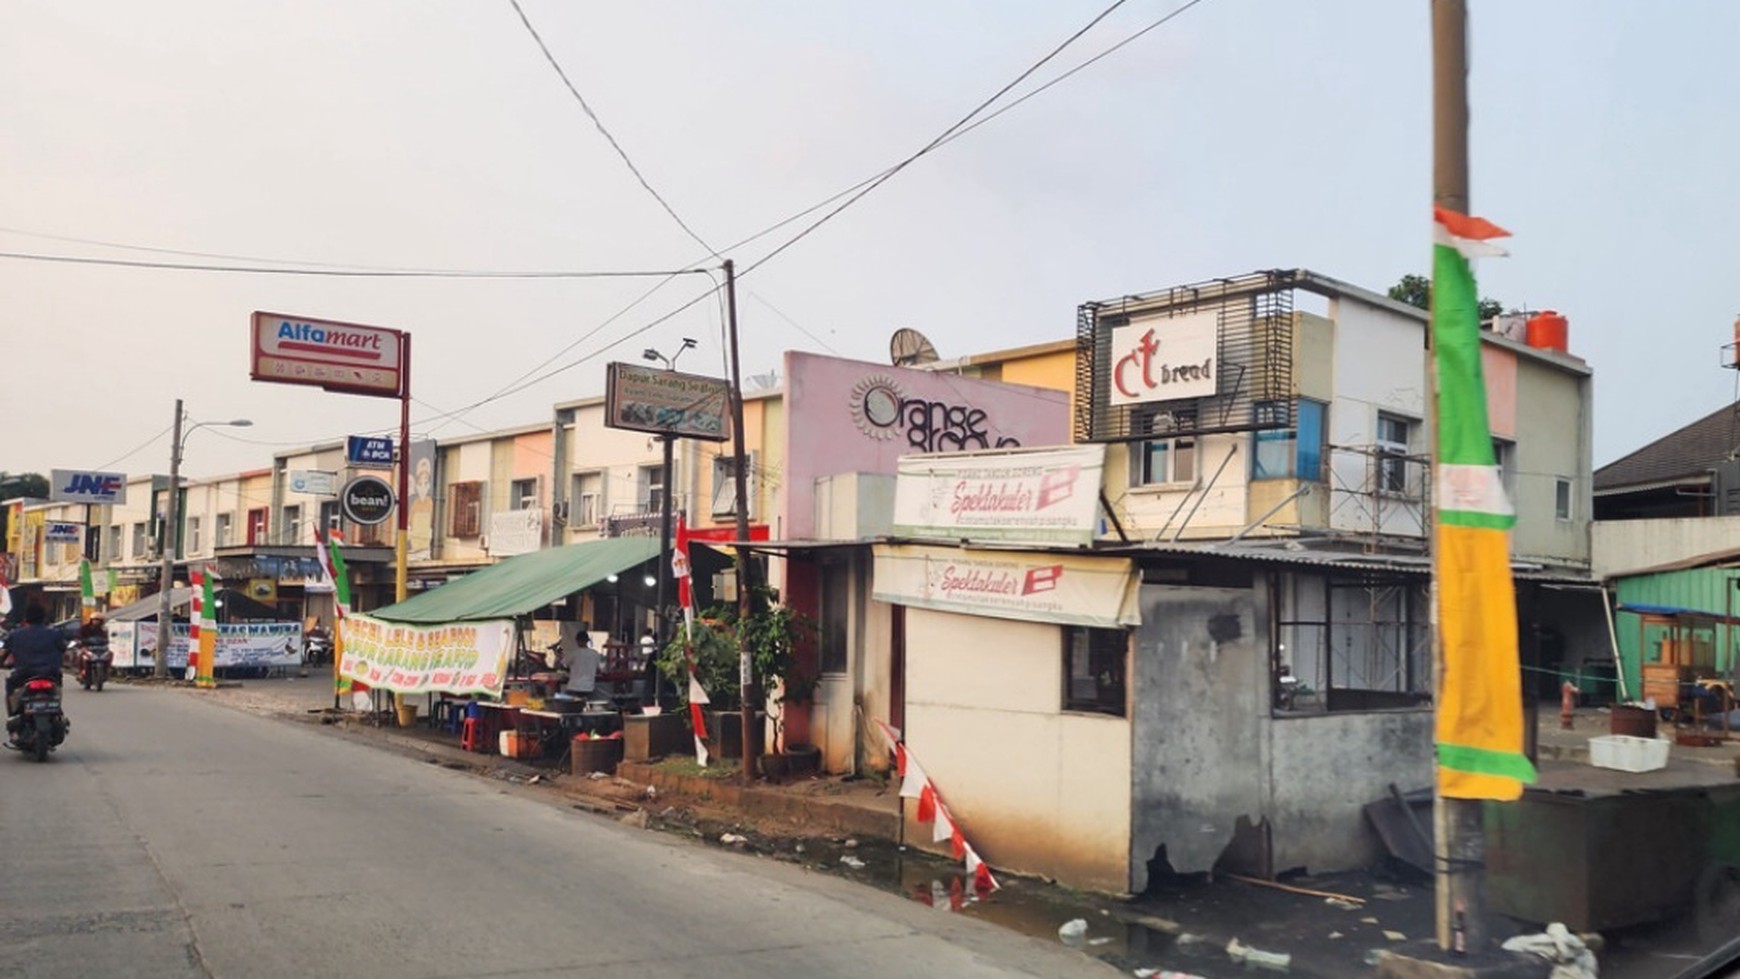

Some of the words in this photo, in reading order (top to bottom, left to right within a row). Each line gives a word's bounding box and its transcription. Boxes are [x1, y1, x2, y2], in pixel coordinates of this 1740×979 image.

[278, 321, 382, 350] Alfamart
[619, 370, 650, 385] Dapur
[652, 373, 686, 390] Sarang
[1161, 358, 1211, 384] bread
[864, 386, 988, 440] Orange
[366, 440, 385, 449] ATM
[372, 450, 390, 459] BCA
[63, 474, 122, 495] JNE
[351, 493, 388, 507] bean!
[951, 481, 1032, 520] Spektakuler
[50, 525, 78, 534] JNE
[941, 566, 1018, 595] Spektakuler
[385, 627, 414, 649] LELE
